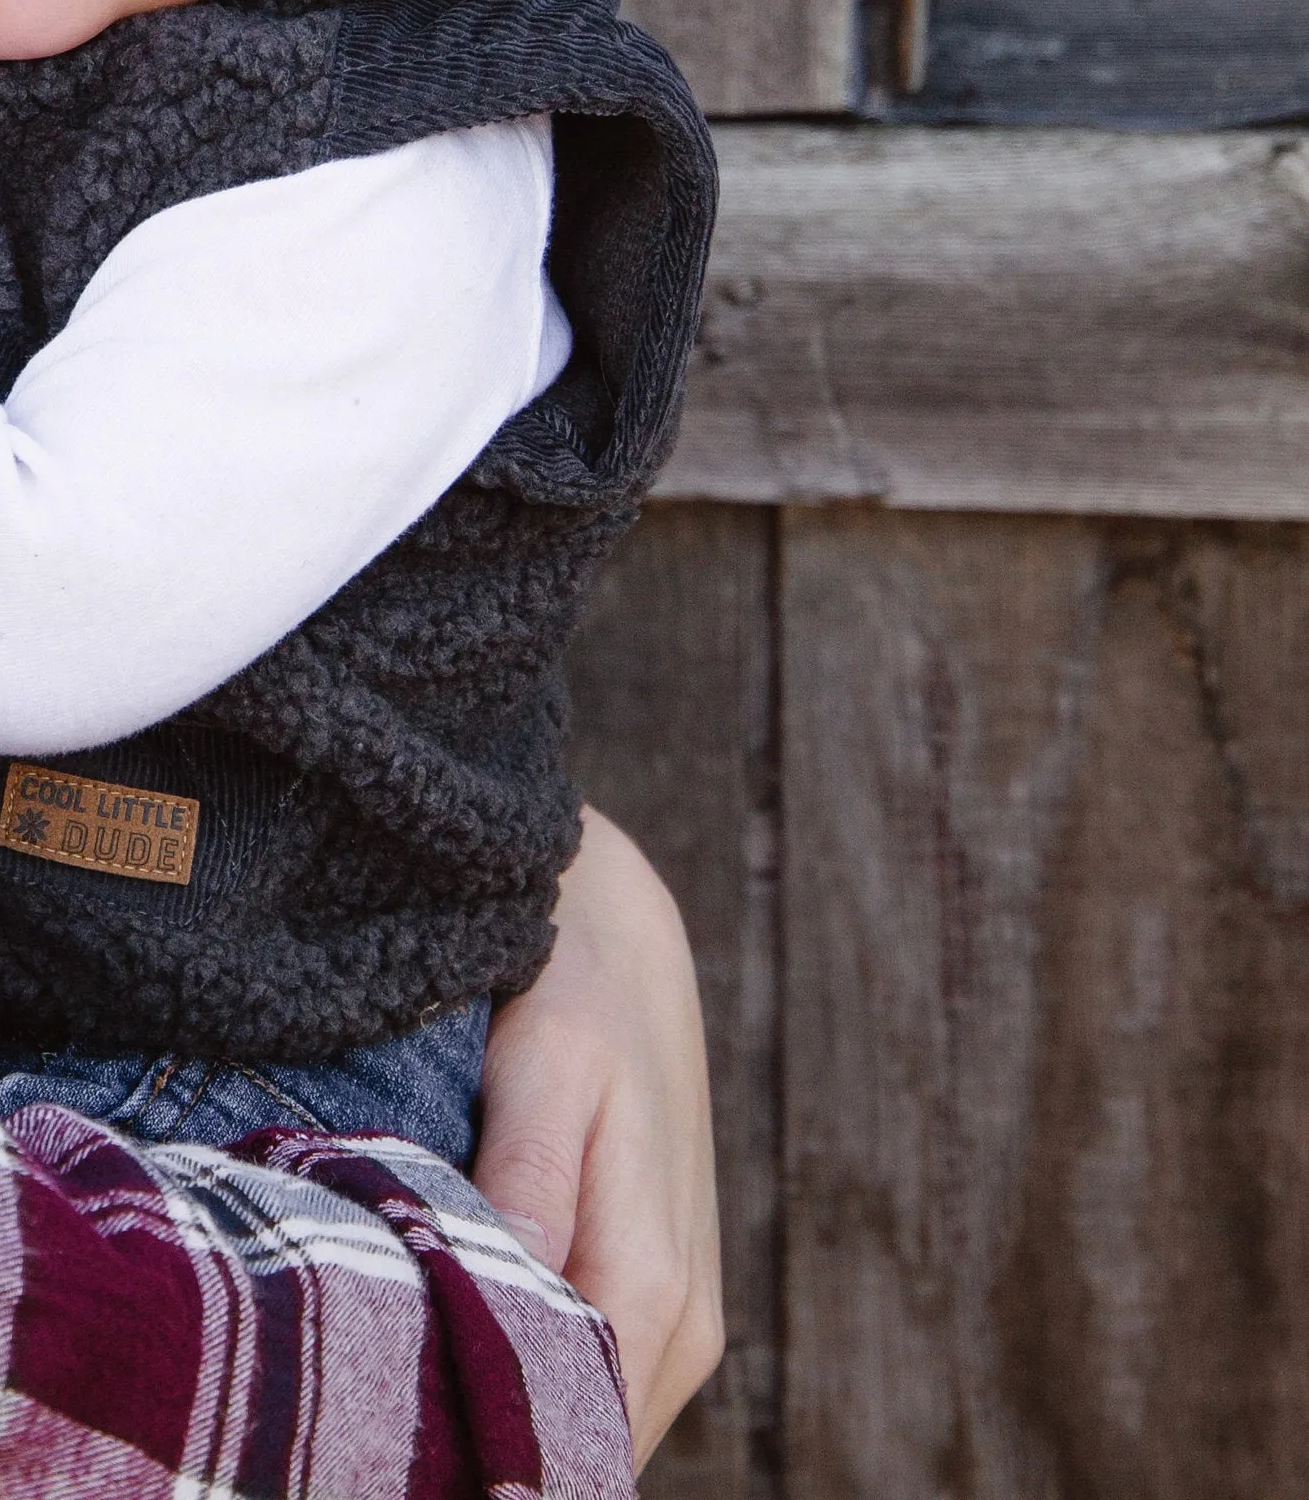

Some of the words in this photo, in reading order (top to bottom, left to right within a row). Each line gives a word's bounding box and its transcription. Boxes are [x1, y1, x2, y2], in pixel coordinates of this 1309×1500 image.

[21, 776, 86, 813] COOL
[97, 794, 186, 831] LITTLE
[62, 819, 179, 871] DUDE
